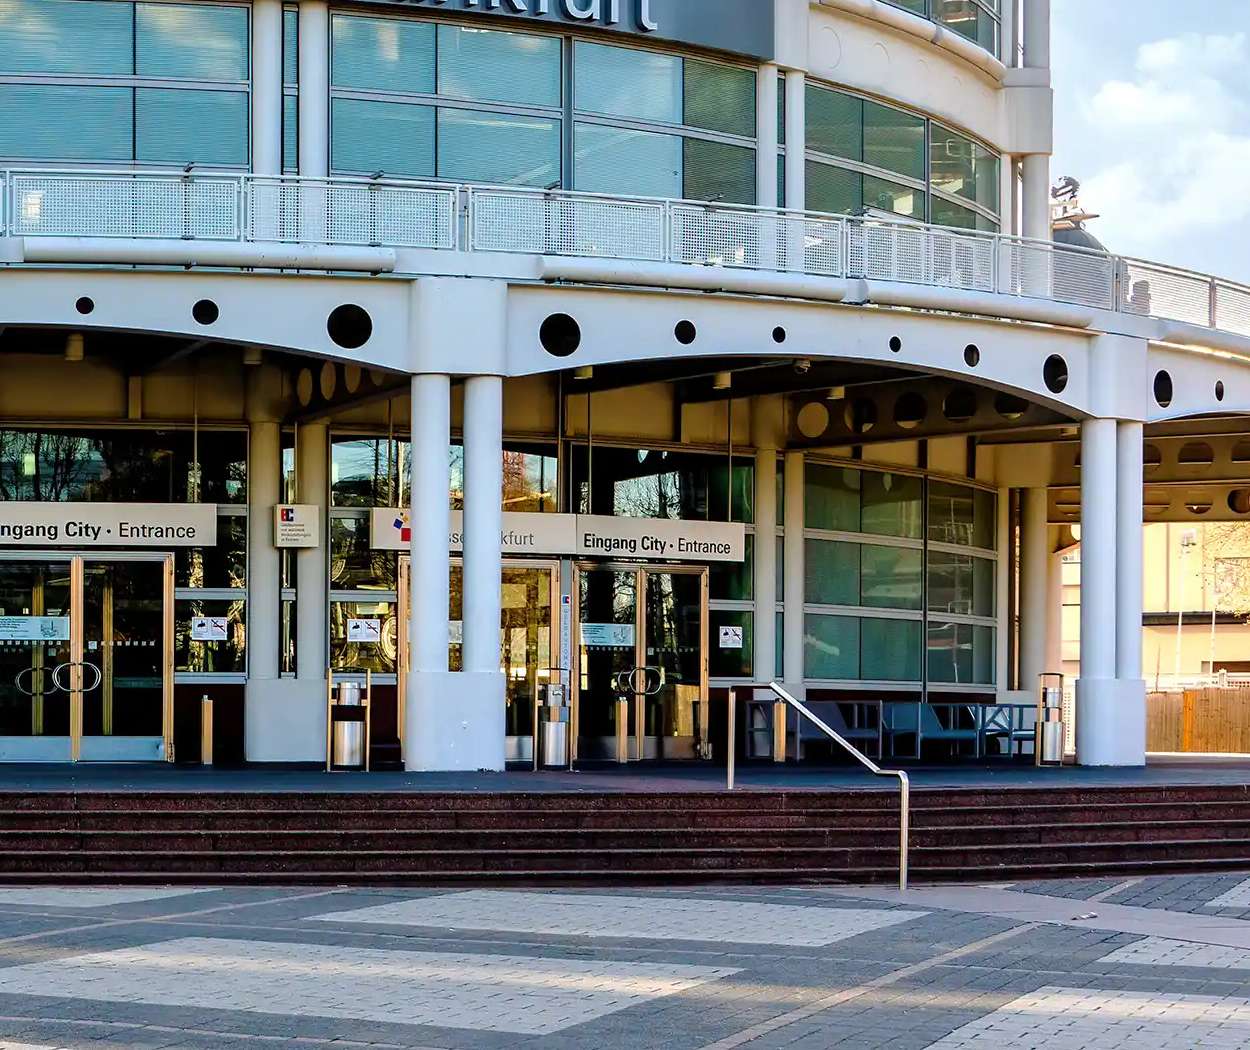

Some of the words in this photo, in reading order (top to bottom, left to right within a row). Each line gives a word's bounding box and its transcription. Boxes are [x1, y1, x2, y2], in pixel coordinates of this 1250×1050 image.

[65, 521, 102, 541] City
[118, 521, 196, 539] Entrance
[583, 532, 637, 554] Eingang
[640, 535, 667, 554] City
[678, 537, 731, 555] Entrance
